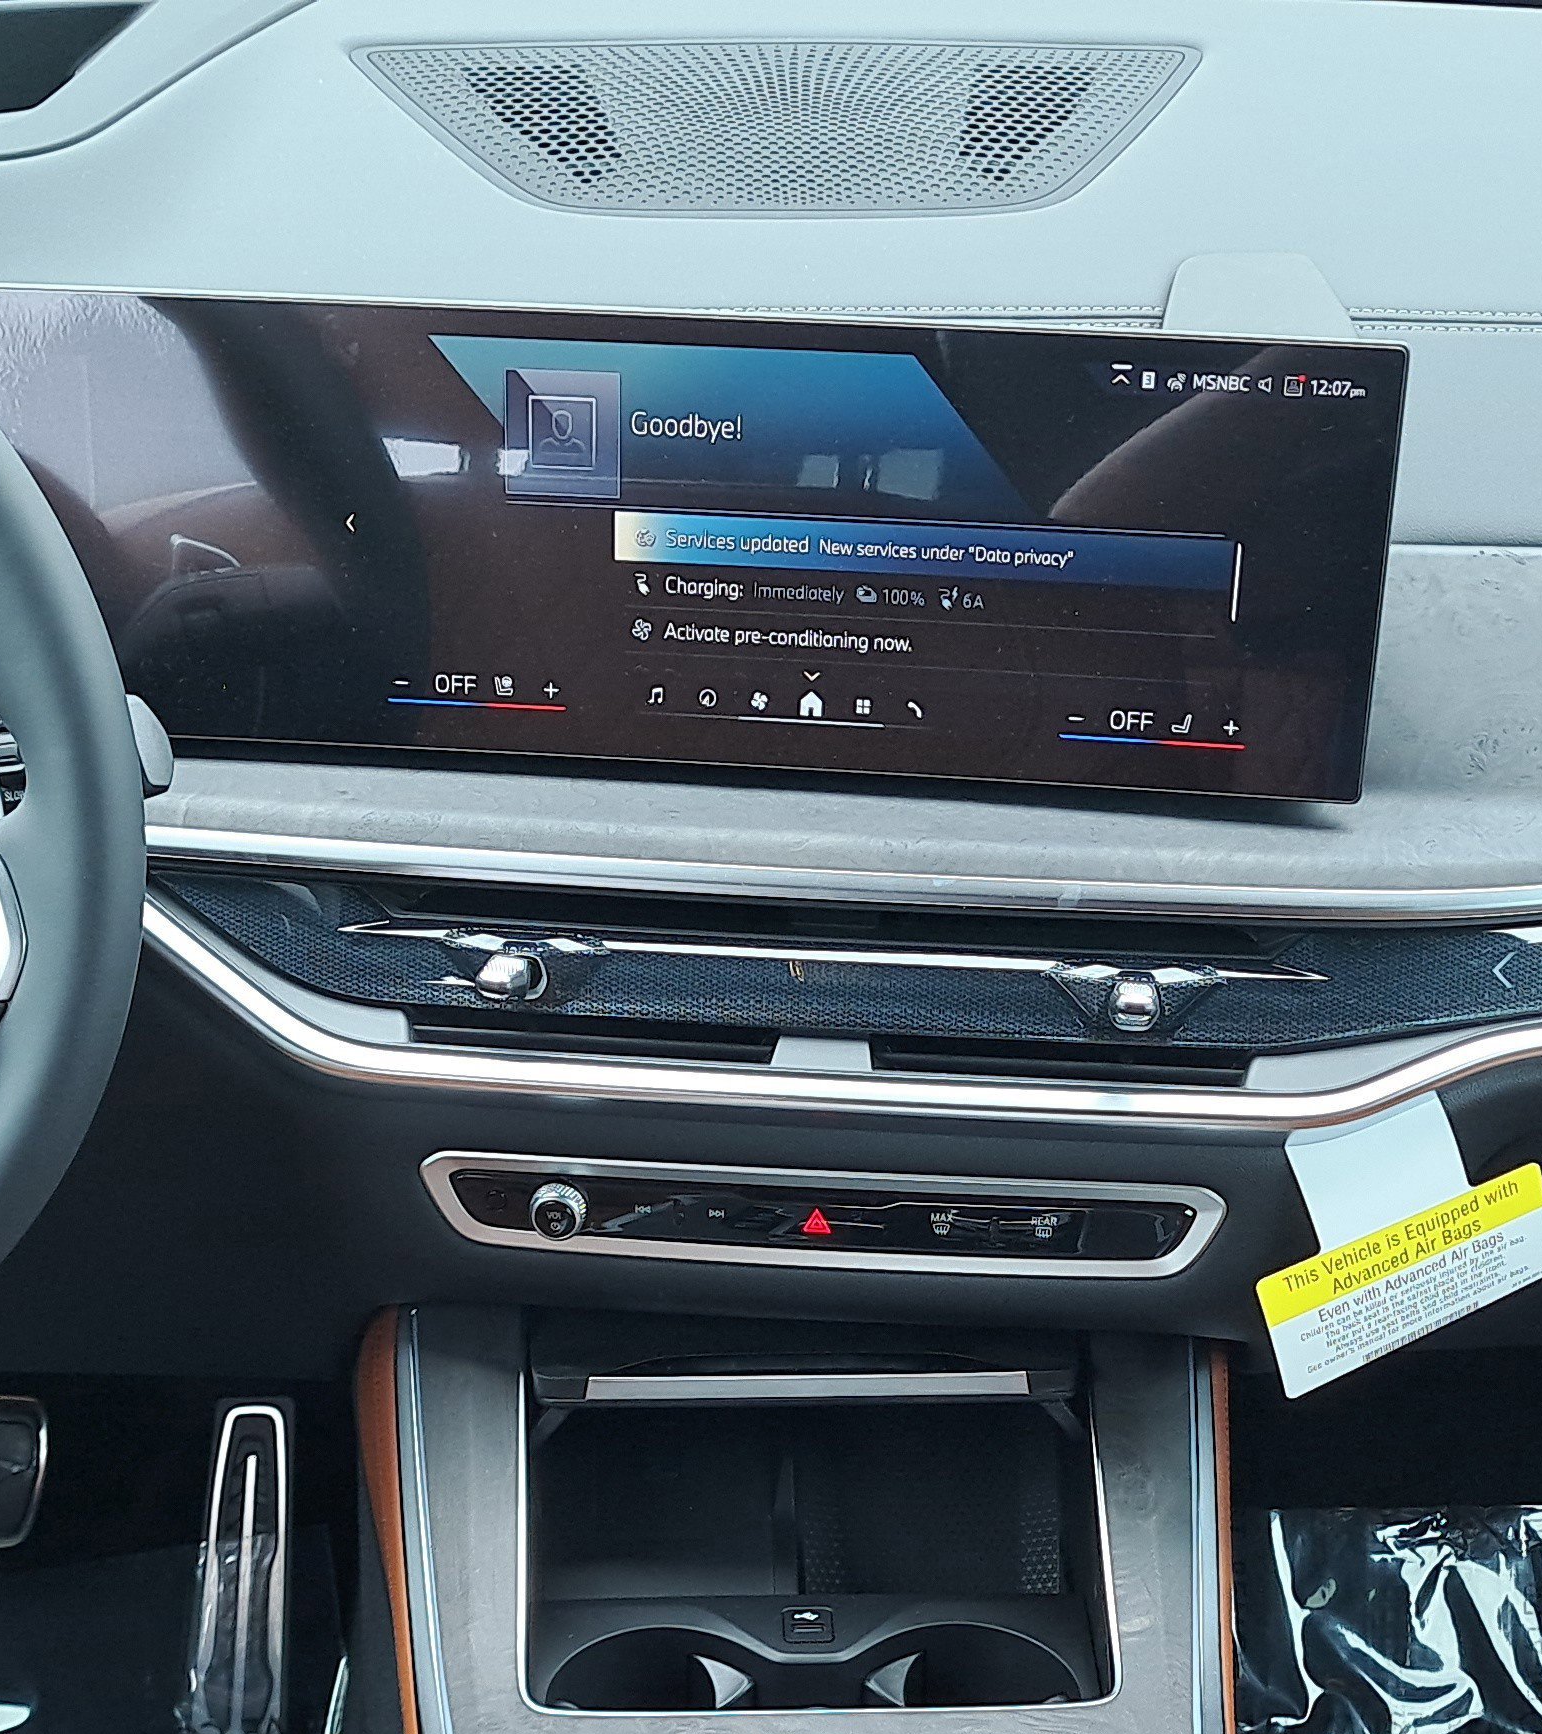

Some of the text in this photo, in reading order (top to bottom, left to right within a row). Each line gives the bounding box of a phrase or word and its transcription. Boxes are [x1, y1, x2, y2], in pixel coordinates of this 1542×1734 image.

[1192, 373, 1251, 392] MSNBC
[631, 411, 742, 444] Goodbye!
[665, 529, 1075, 569] Services updated New services under "Data privacy"
[665, 576, 985, 610] Charging: Immediately 100% 6A
[663, 622, 913, 653] Activate pre-conditioning now.
[435, 674, 477, 695] OFF
[1110, 710, 1154, 732] OFF
[930, 1212, 954, 1223] MAX
[1030, 1216, 1059, 1226] REAR
[1281, 1180, 1518, 1292] This Vehicle is Equipped with
[1333, 1219, 1481, 1294] Advanced Air Bags
[1317, 1231, 1503, 1322] Even with Advanced Air Bags
